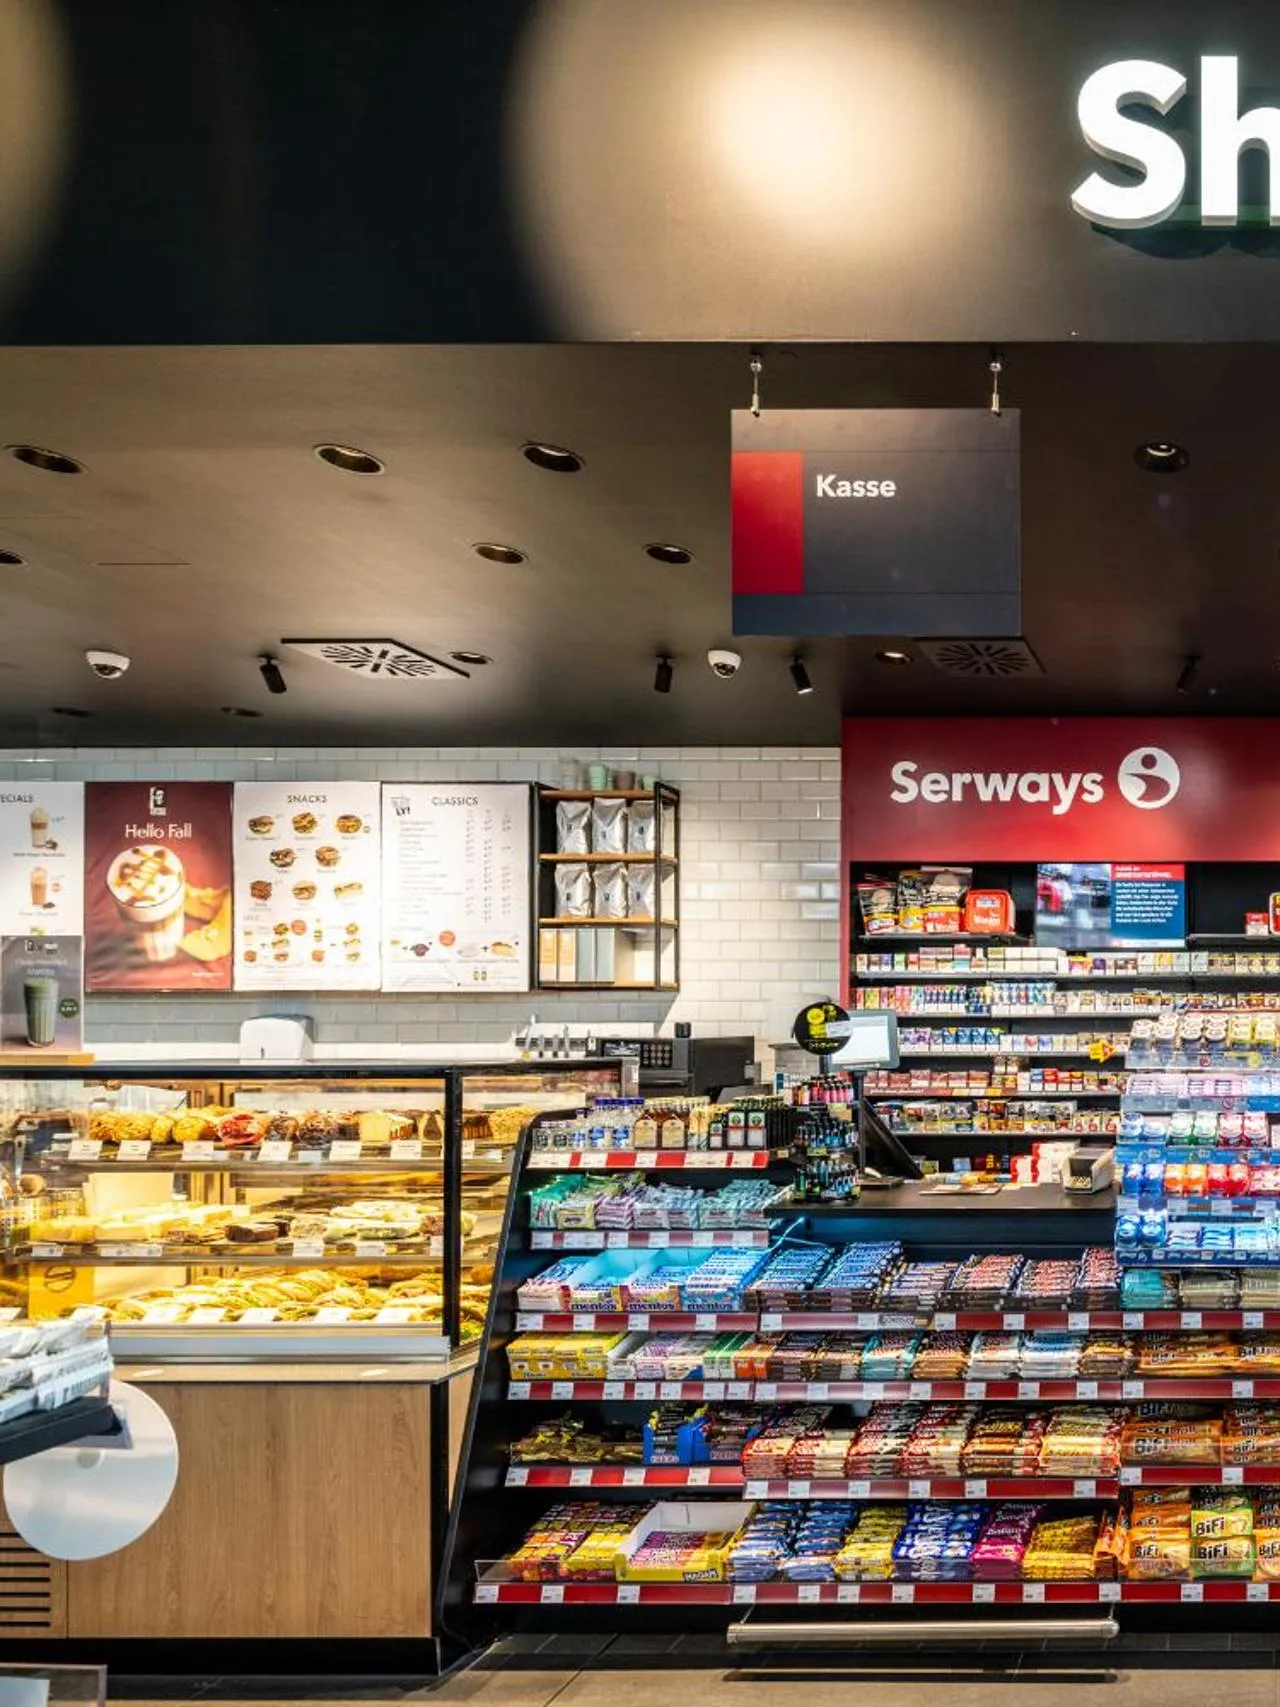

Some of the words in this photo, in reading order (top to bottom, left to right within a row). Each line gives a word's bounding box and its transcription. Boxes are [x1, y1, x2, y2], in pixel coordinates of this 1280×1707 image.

[816, 474, 897, 498] Kasse
[890, 760, 1105, 815] Serways
[286, 794, 328, 804] SNACKS
[430, 796, 479, 807] CLASSICS
[125, 823, 164, 839] Hello
[168, 823, 192, 839] Fall
[570, 1302, 617, 1311] mentos
[629, 1302, 675, 1311] mentos
[686, 1302, 734, 1311] mentos
[1194, 1516, 1226, 1536] BiFi
[1134, 1543, 1159, 1558] BiFi
[1198, 1542, 1229, 1560] BiFi
